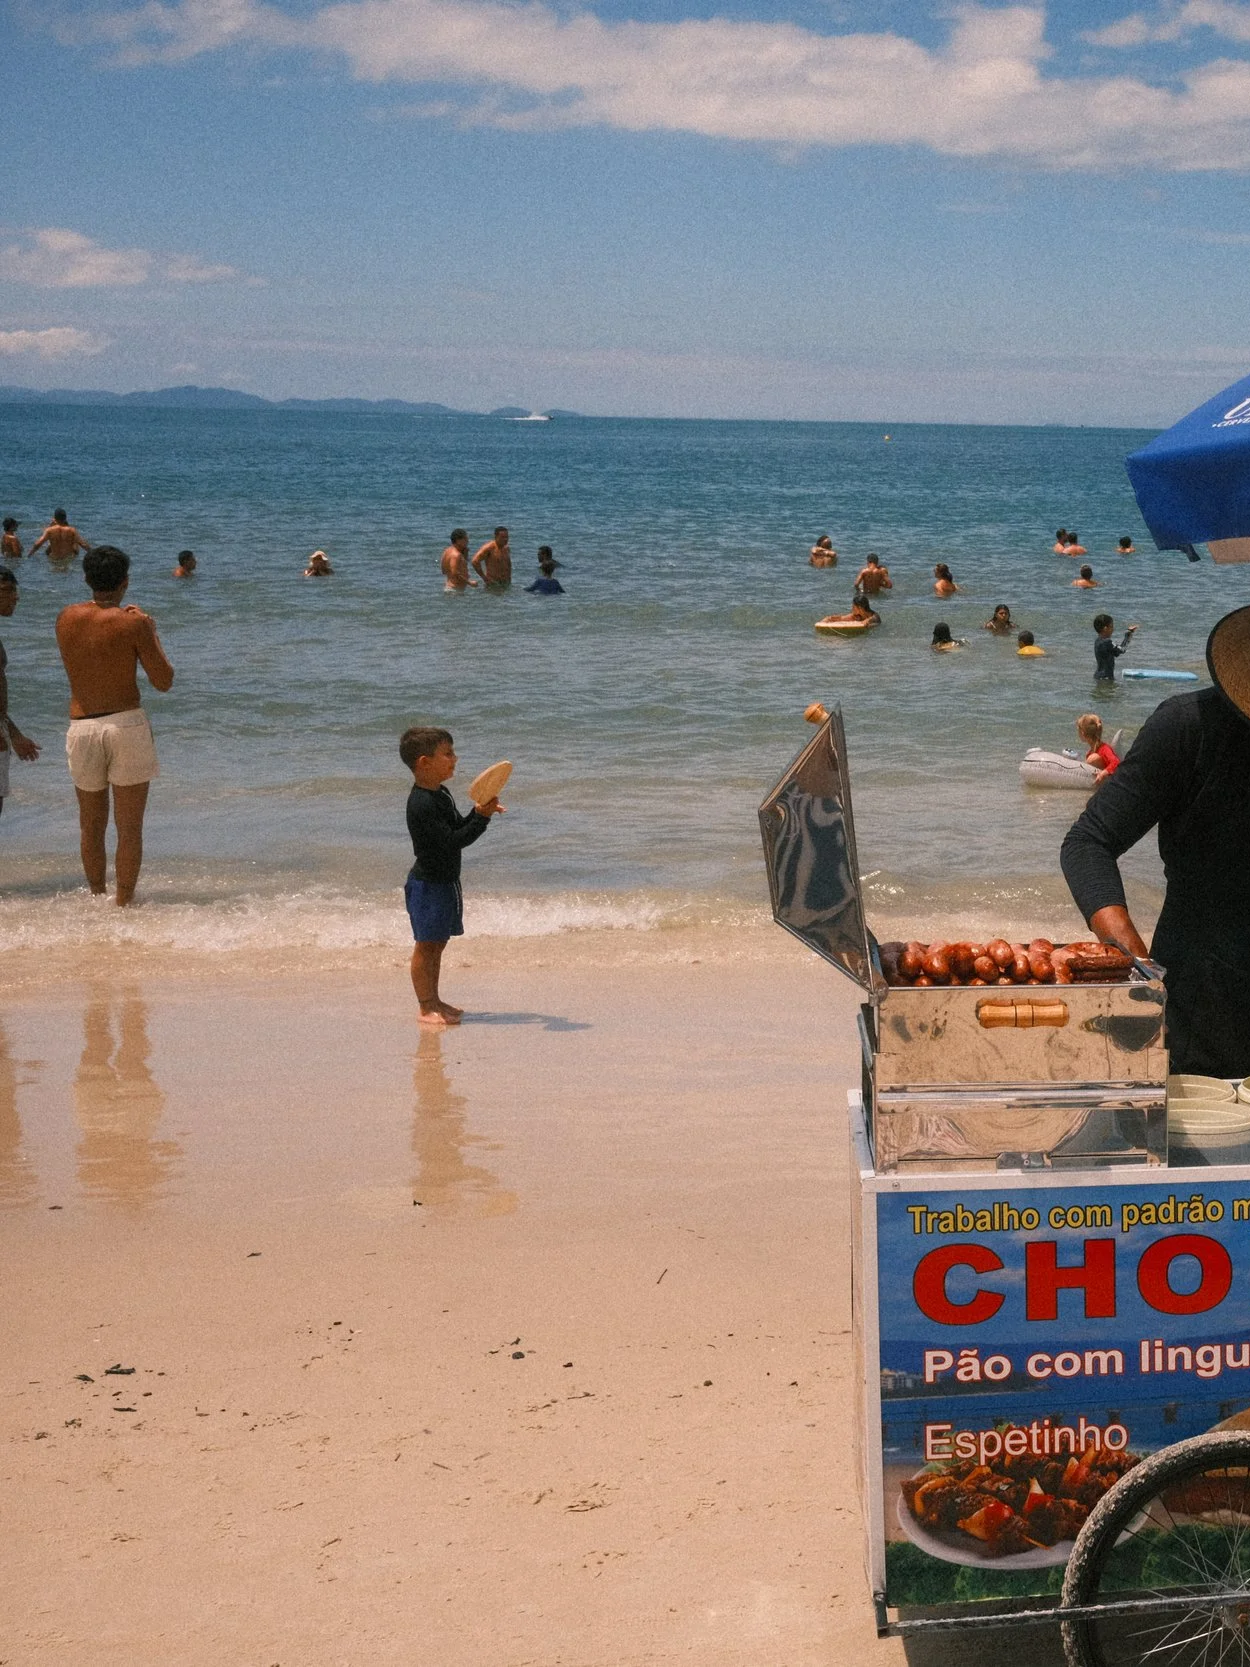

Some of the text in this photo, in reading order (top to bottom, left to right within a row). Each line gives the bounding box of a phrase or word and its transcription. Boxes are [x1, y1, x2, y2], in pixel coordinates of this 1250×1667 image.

[907, 1202, 1040, 1234] Trabalho
[1048, 1204, 1112, 1231] com
[1121, 1194, 1224, 1232] padrão
[923, 1347, 1012, 1383] Pão
[1026, 1348, 1124, 1378] com
[924, 1416, 1129, 1466] Espetinho
